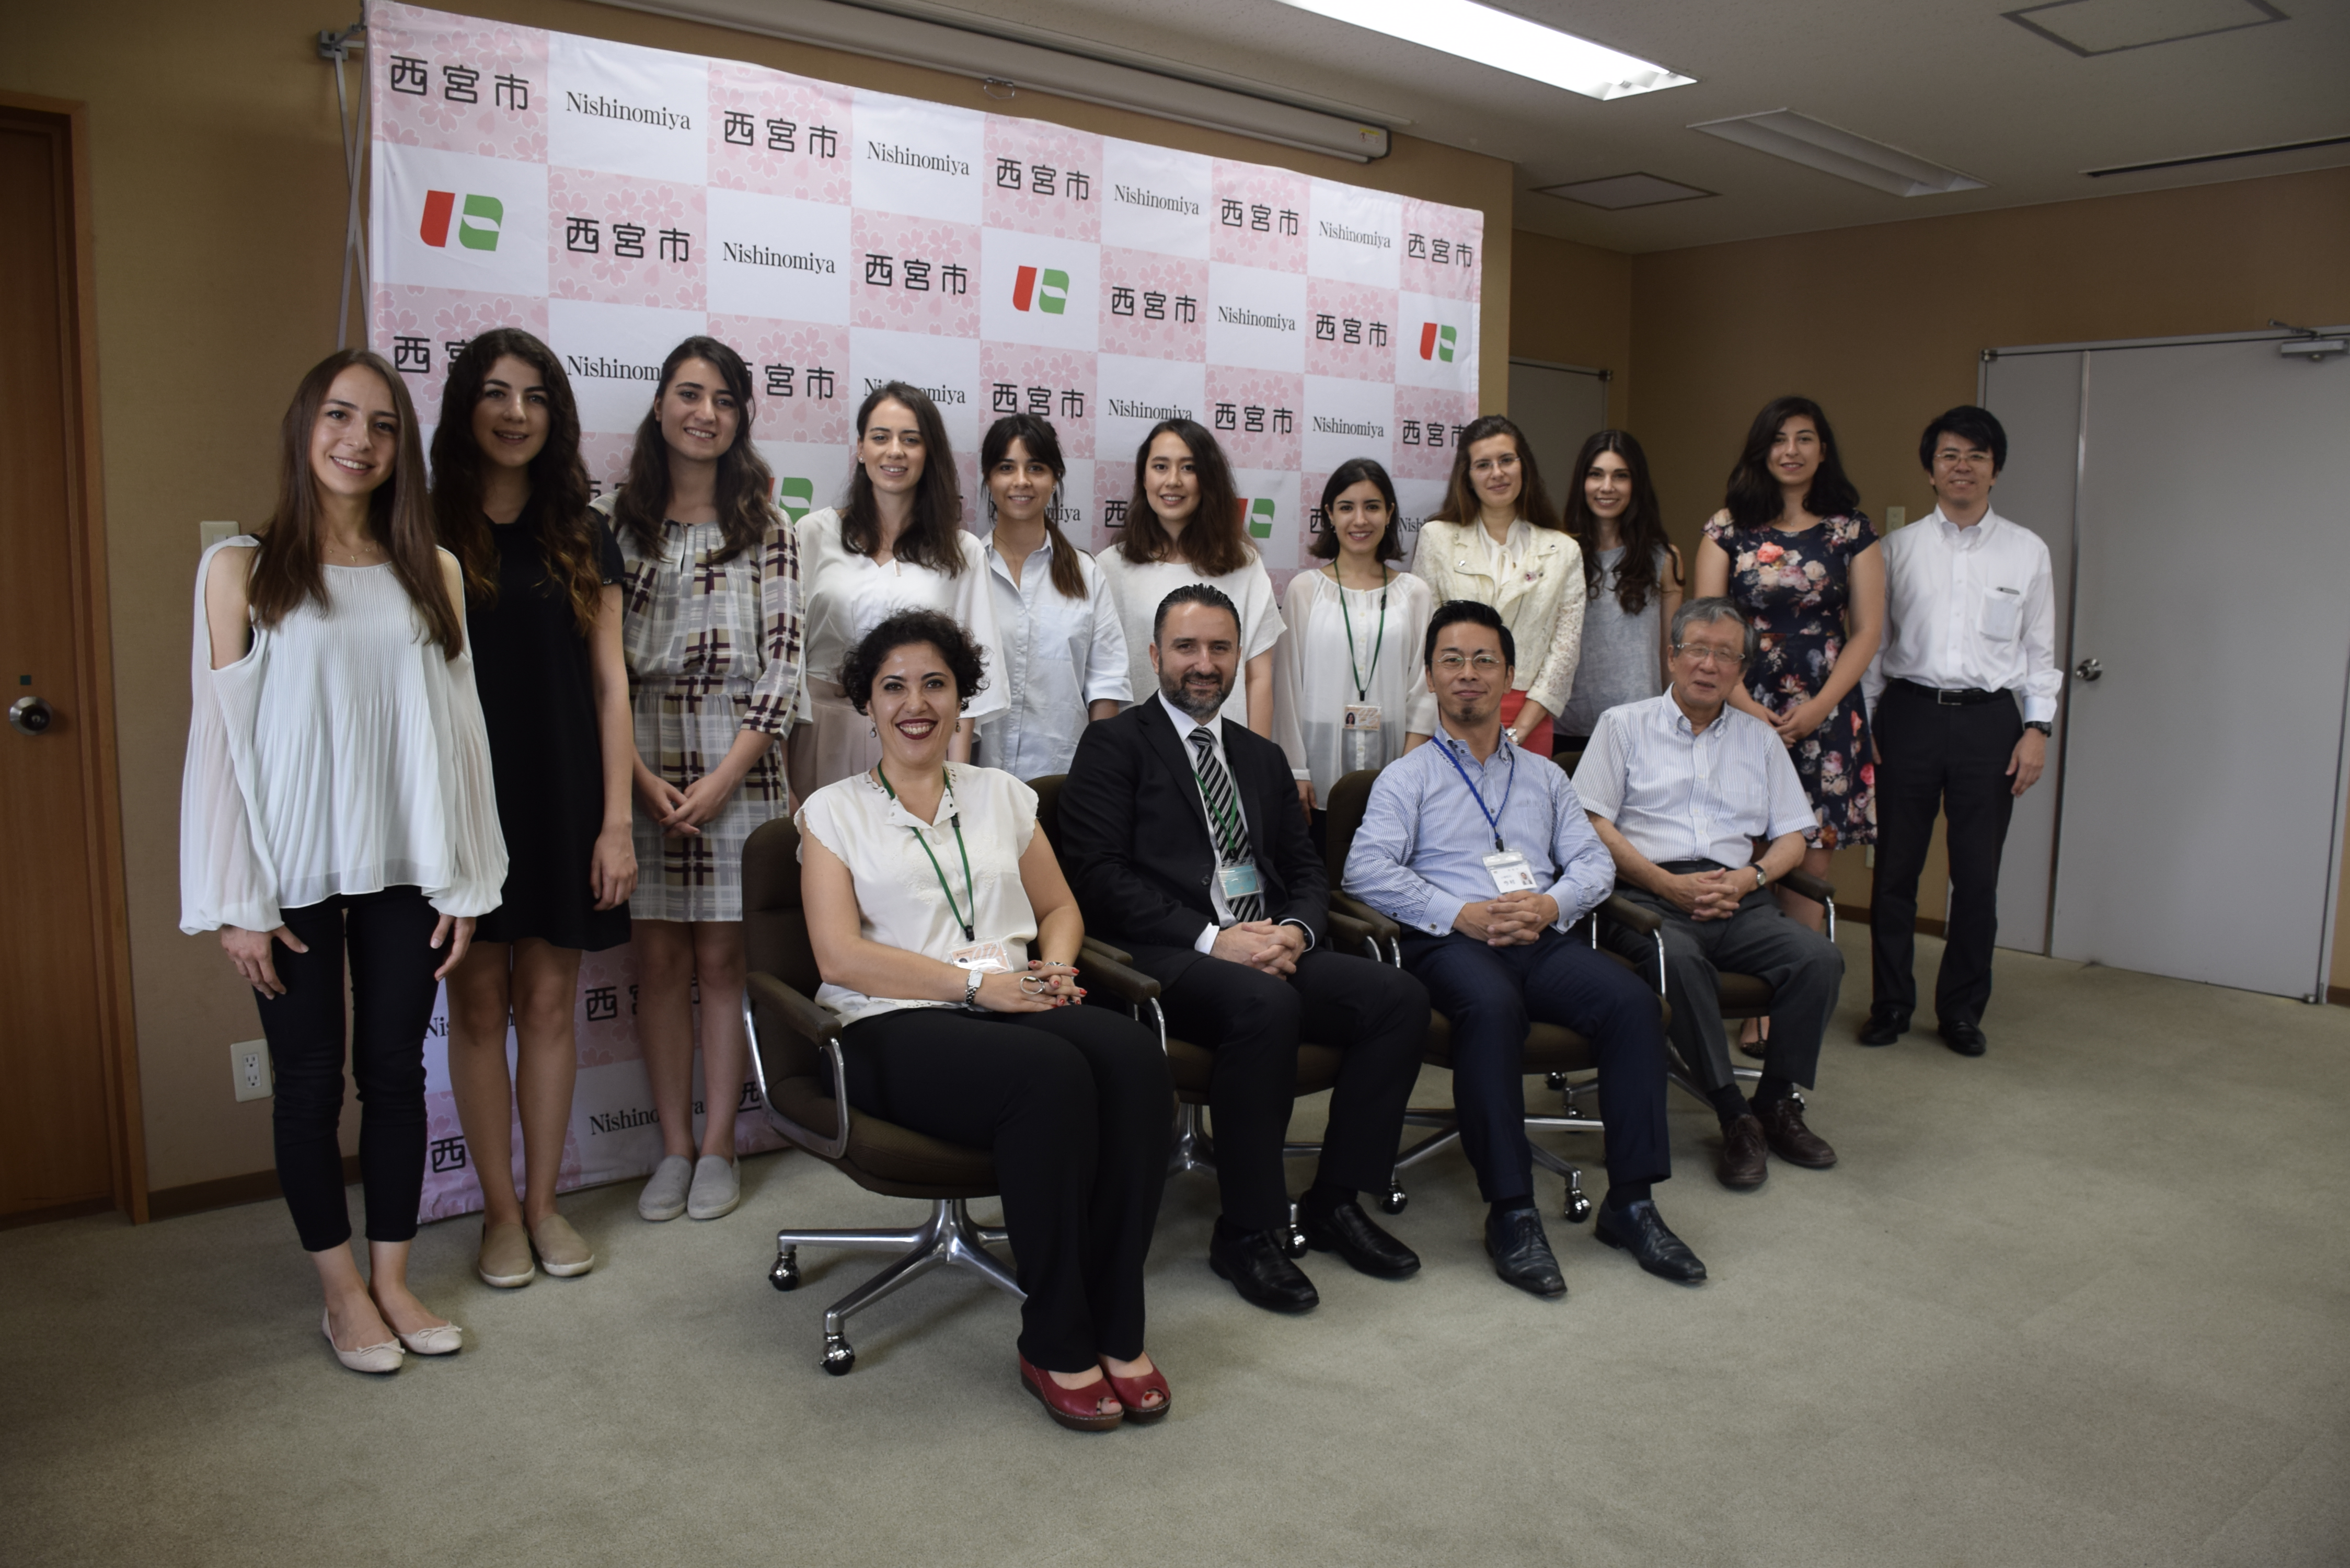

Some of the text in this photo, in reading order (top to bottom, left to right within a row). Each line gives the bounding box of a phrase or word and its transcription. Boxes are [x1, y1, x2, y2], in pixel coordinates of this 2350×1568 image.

[390, 55, 529, 111] 西宮市
[567, 91, 690, 130] Nishinomiya
[724, 110, 838, 159] 西宮市
[868, 141, 970, 176] Nishinomiya
[997, 157, 1090, 201] 西宮市
[1115, 184, 1199, 215] Nishinomiya
[1222, 199, 1299, 236] 西宮市
[1319, 221, 1391, 248] Nishinomiya
[566, 216, 690, 263] 西宮市
[1408, 233, 1472, 268] 西宮市
[723, 242, 835, 274] Nishinomiya
[865, 253, 967, 295] 西宮市
[1112, 286, 1196, 324] 西宮市
[1218, 306, 1295, 331] Nishinomiya
[1316, 314, 1388, 348] 西宮市
[567, 355, 661, 381] Nishinom
[744, 362, 835, 400] 宮市
[993, 383, 1085, 419] 西宮市
[1109, 399, 1192, 421] Nishinomiya
[1215, 403, 1293, 434] 西宮市
[1314, 416, 1384, 438] Nishinomiya
